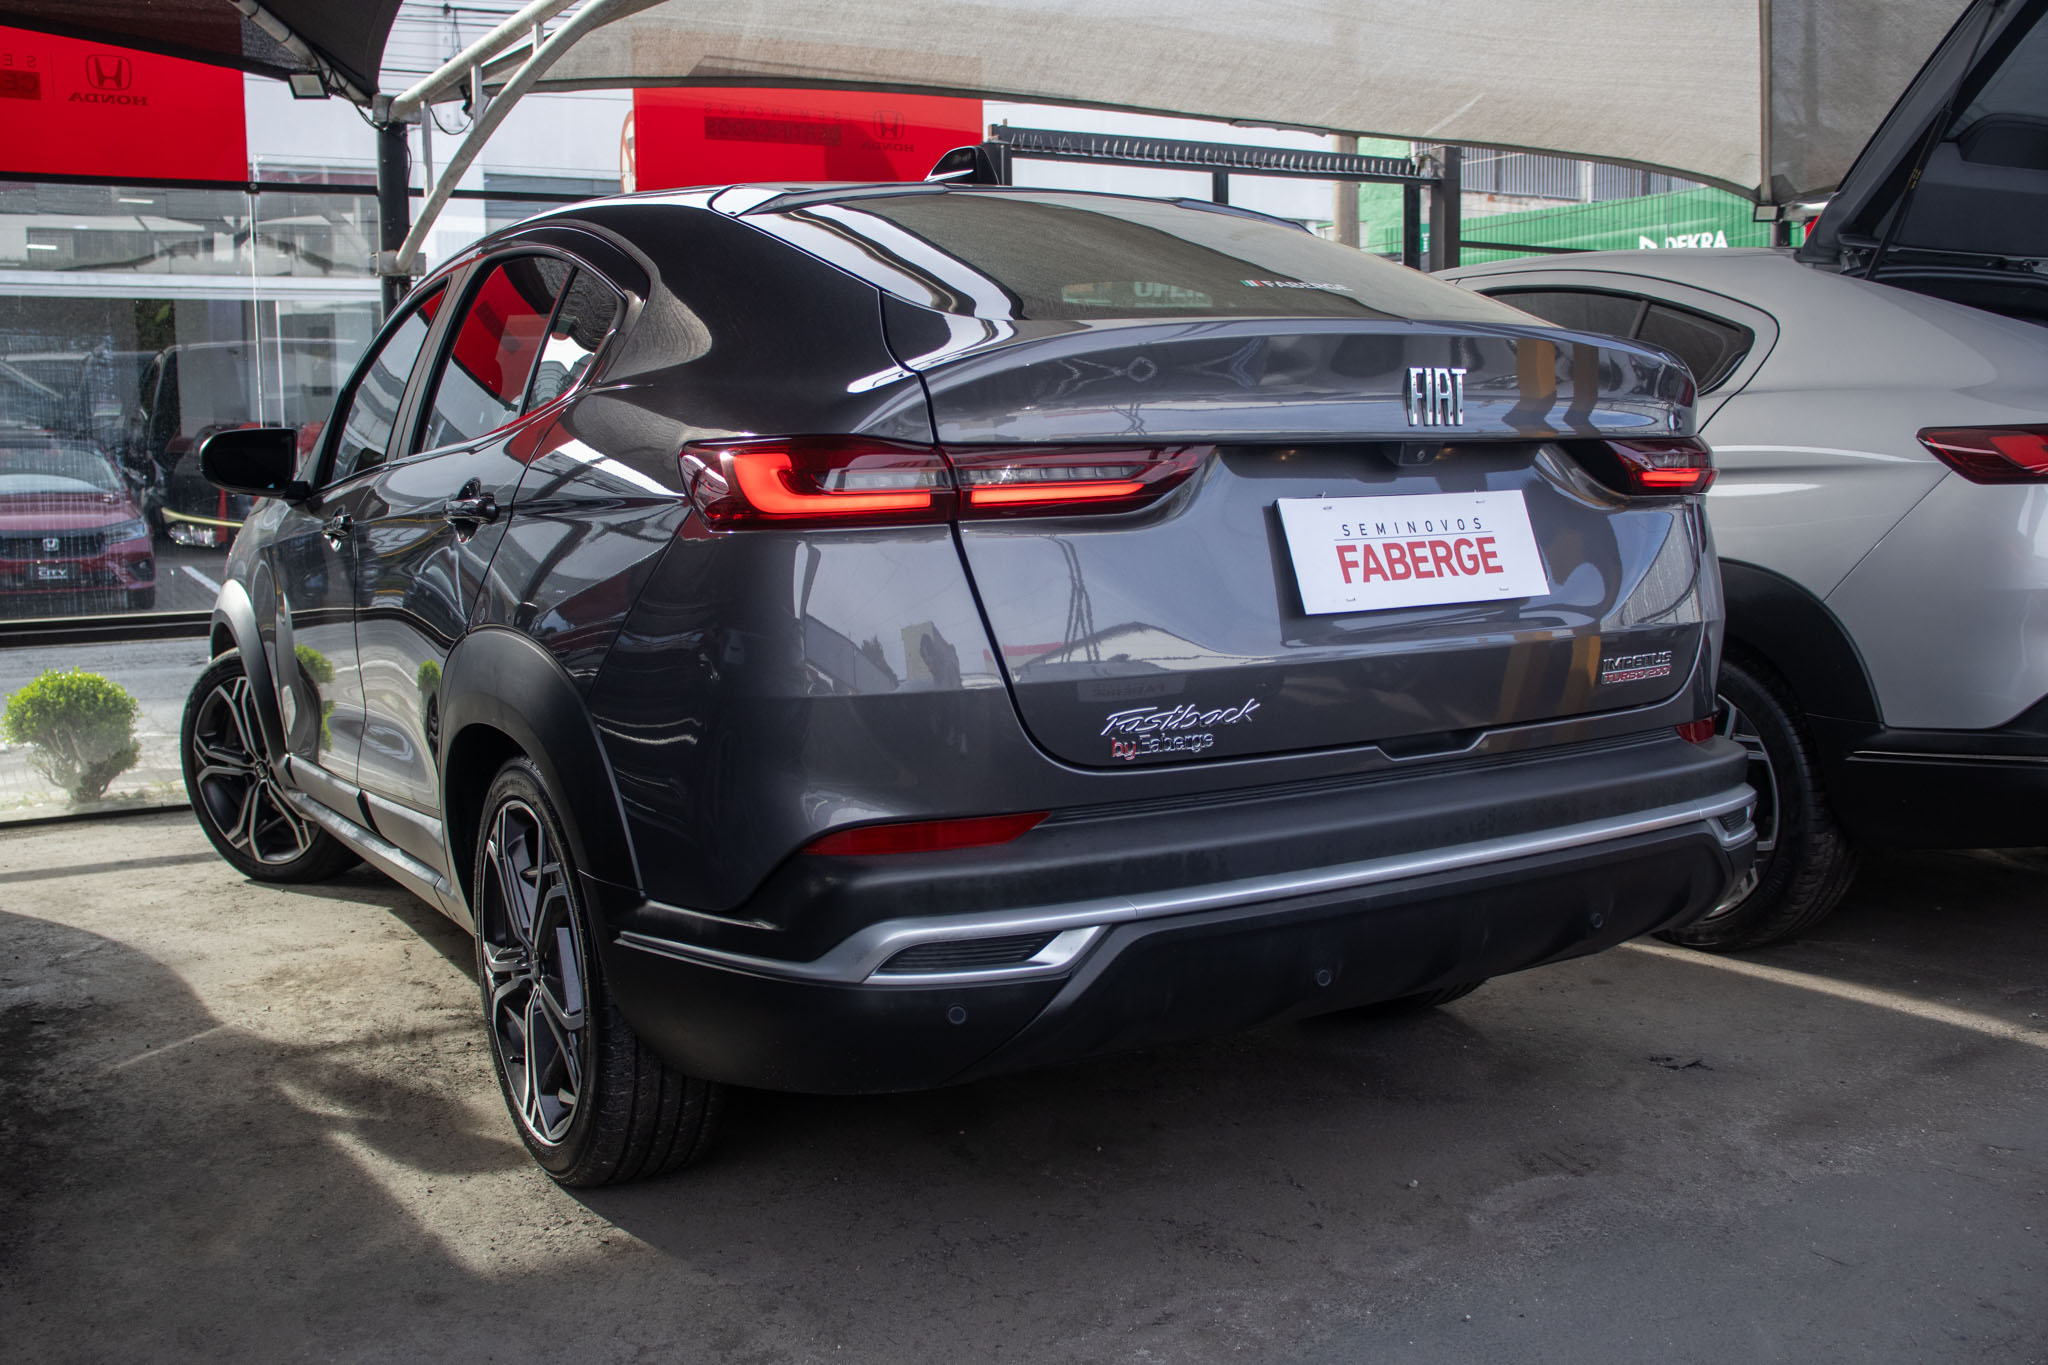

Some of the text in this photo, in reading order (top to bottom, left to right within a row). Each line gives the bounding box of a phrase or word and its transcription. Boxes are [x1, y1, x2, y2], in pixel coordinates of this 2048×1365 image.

[1665, 229, 1728, 248] DEKRA
[1405, 367, 1467, 426] FIAT
[1341, 517, 1483, 537] SEMINOVOS
[1335, 536, 1504, 585] FABERGE
[1602, 650, 1672, 671] IMPETUS
[1100, 698, 1261, 736] Fastback
[1111, 737, 1137, 761] by
